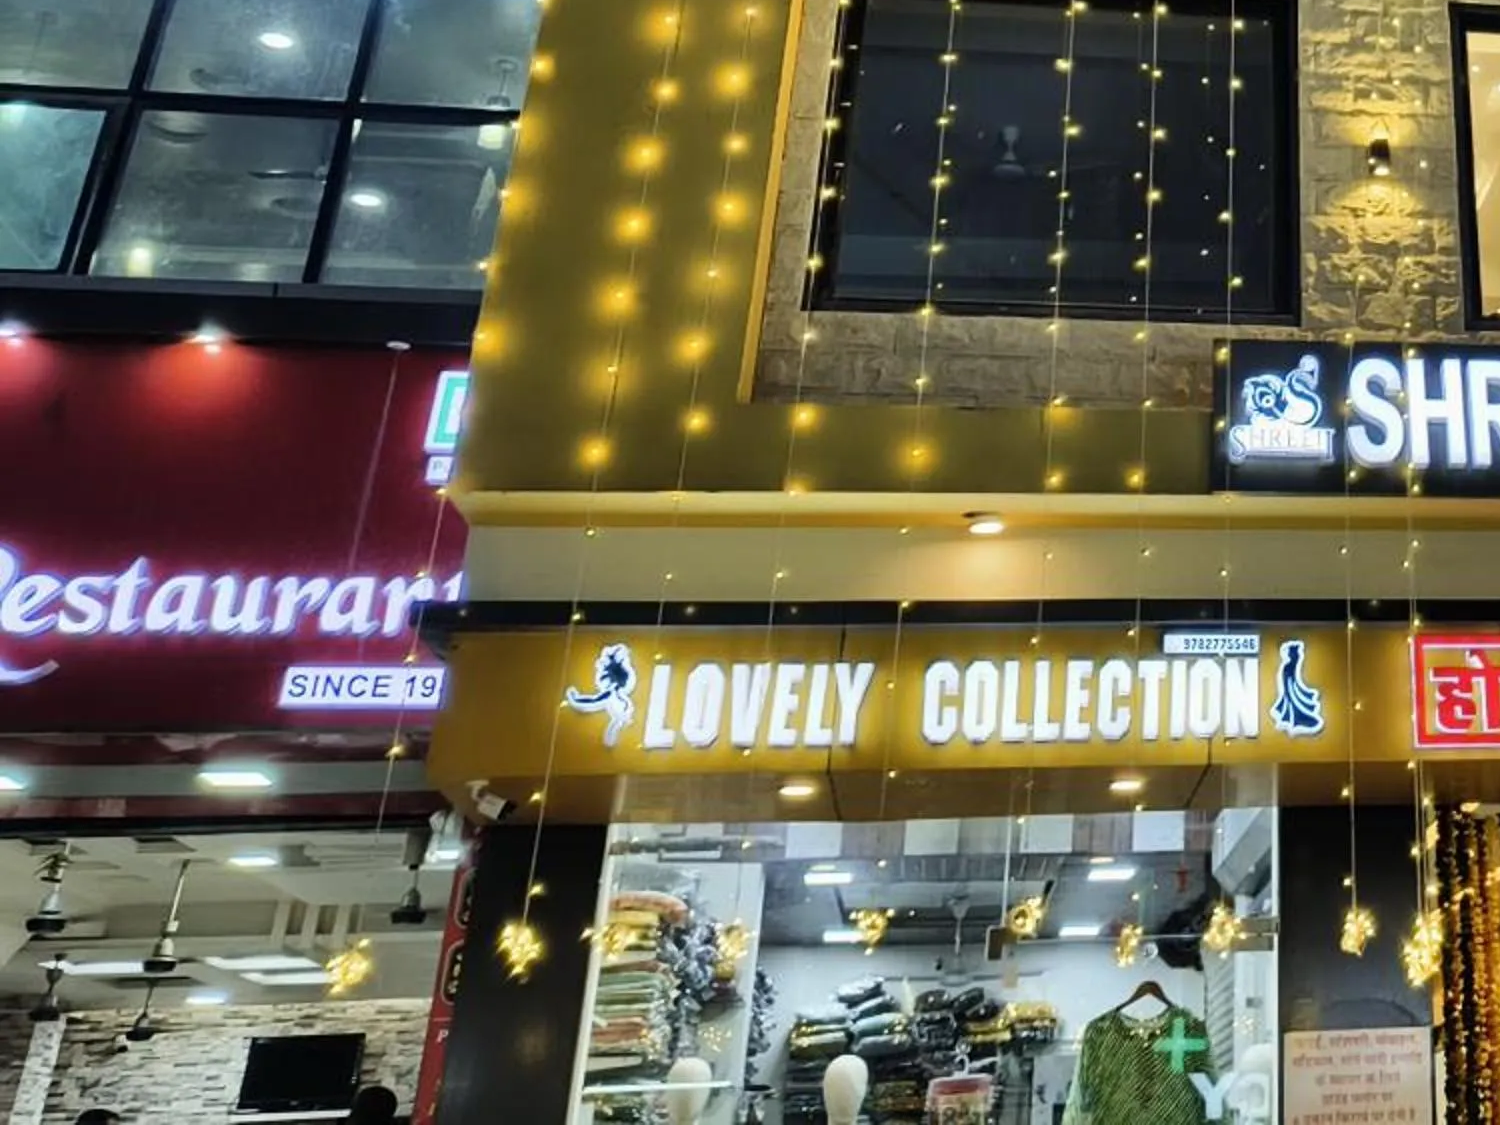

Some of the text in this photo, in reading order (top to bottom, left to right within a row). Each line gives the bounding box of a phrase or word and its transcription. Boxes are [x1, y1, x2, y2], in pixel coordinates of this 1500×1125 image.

[0, 540, 467, 681] estauran
[287, 674, 391, 698] SINCE
[642, 658, 1260, 748] LOVELY COLLECTION
